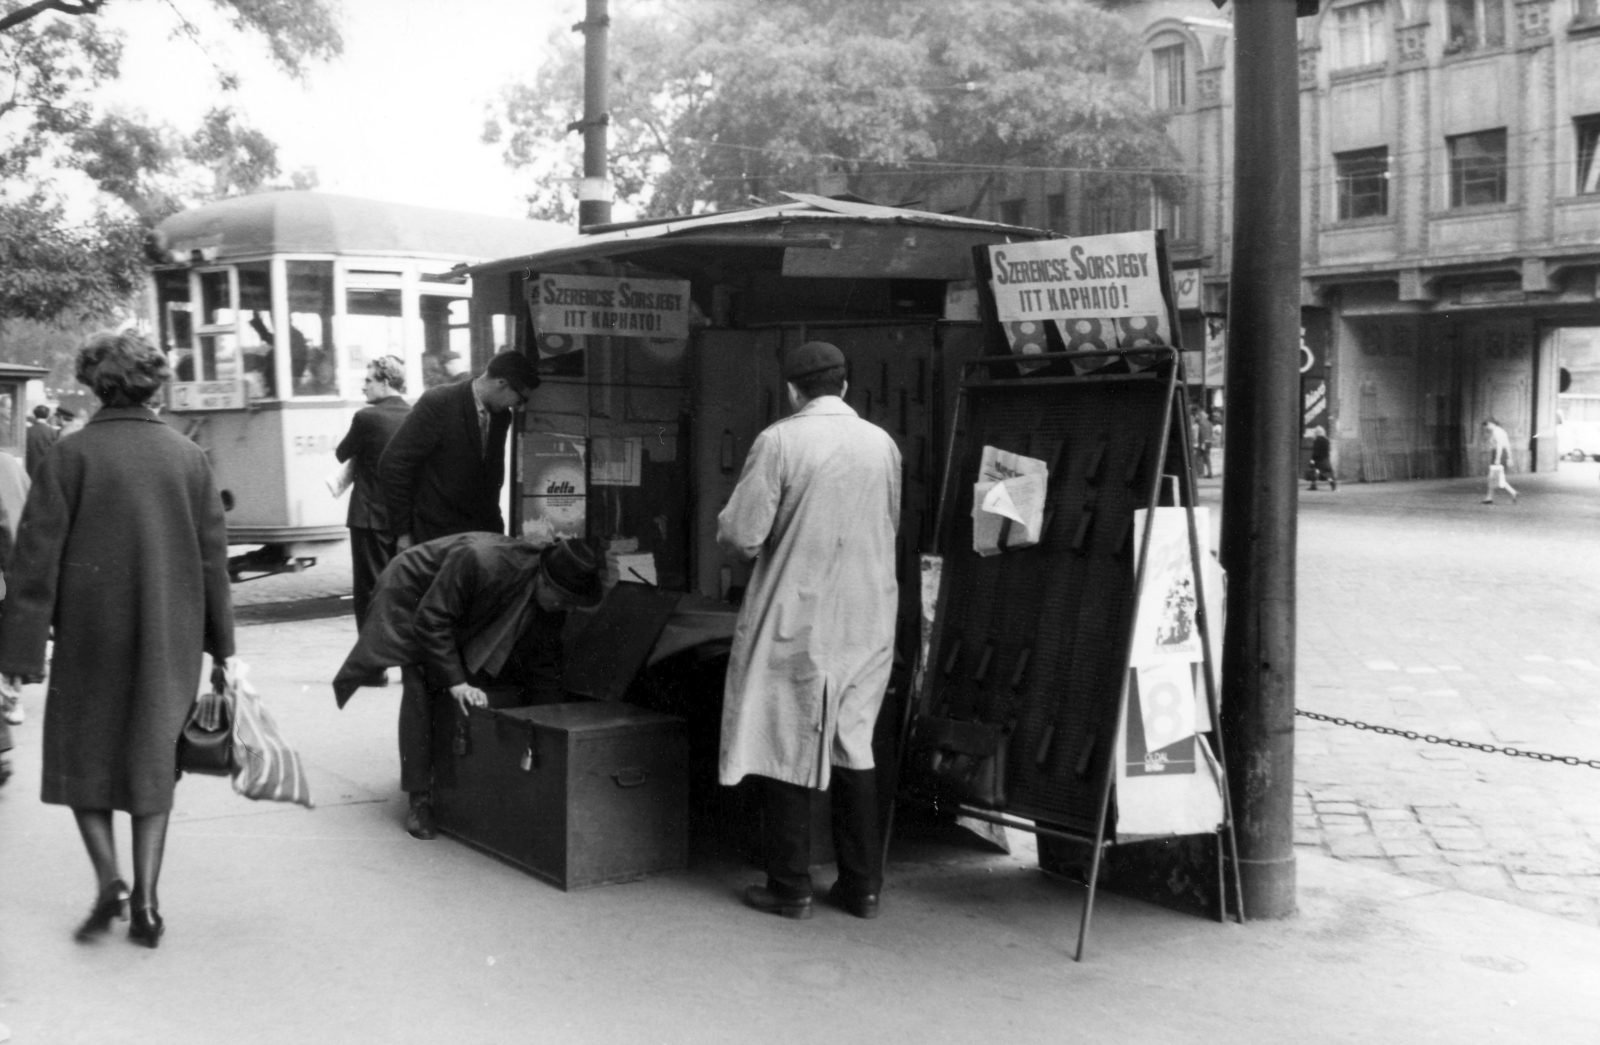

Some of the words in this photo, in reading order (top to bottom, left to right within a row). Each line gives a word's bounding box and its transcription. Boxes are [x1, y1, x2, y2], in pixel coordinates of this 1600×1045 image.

[995, 250, 1072, 285] SZERENCSE
[1070, 245, 1149, 281] SORSJEGY
[543, 278, 616, 308] SZERENCSE
[618, 282, 683, 311] SORSJEGY
[1019, 289, 1043, 312] ITT
[1047, 282, 1129, 312] KAPHATÓ!
[564, 310, 587, 328] ITT
[546, 481, 575, 494] delta
[1146, 681, 1183, 743] 8
